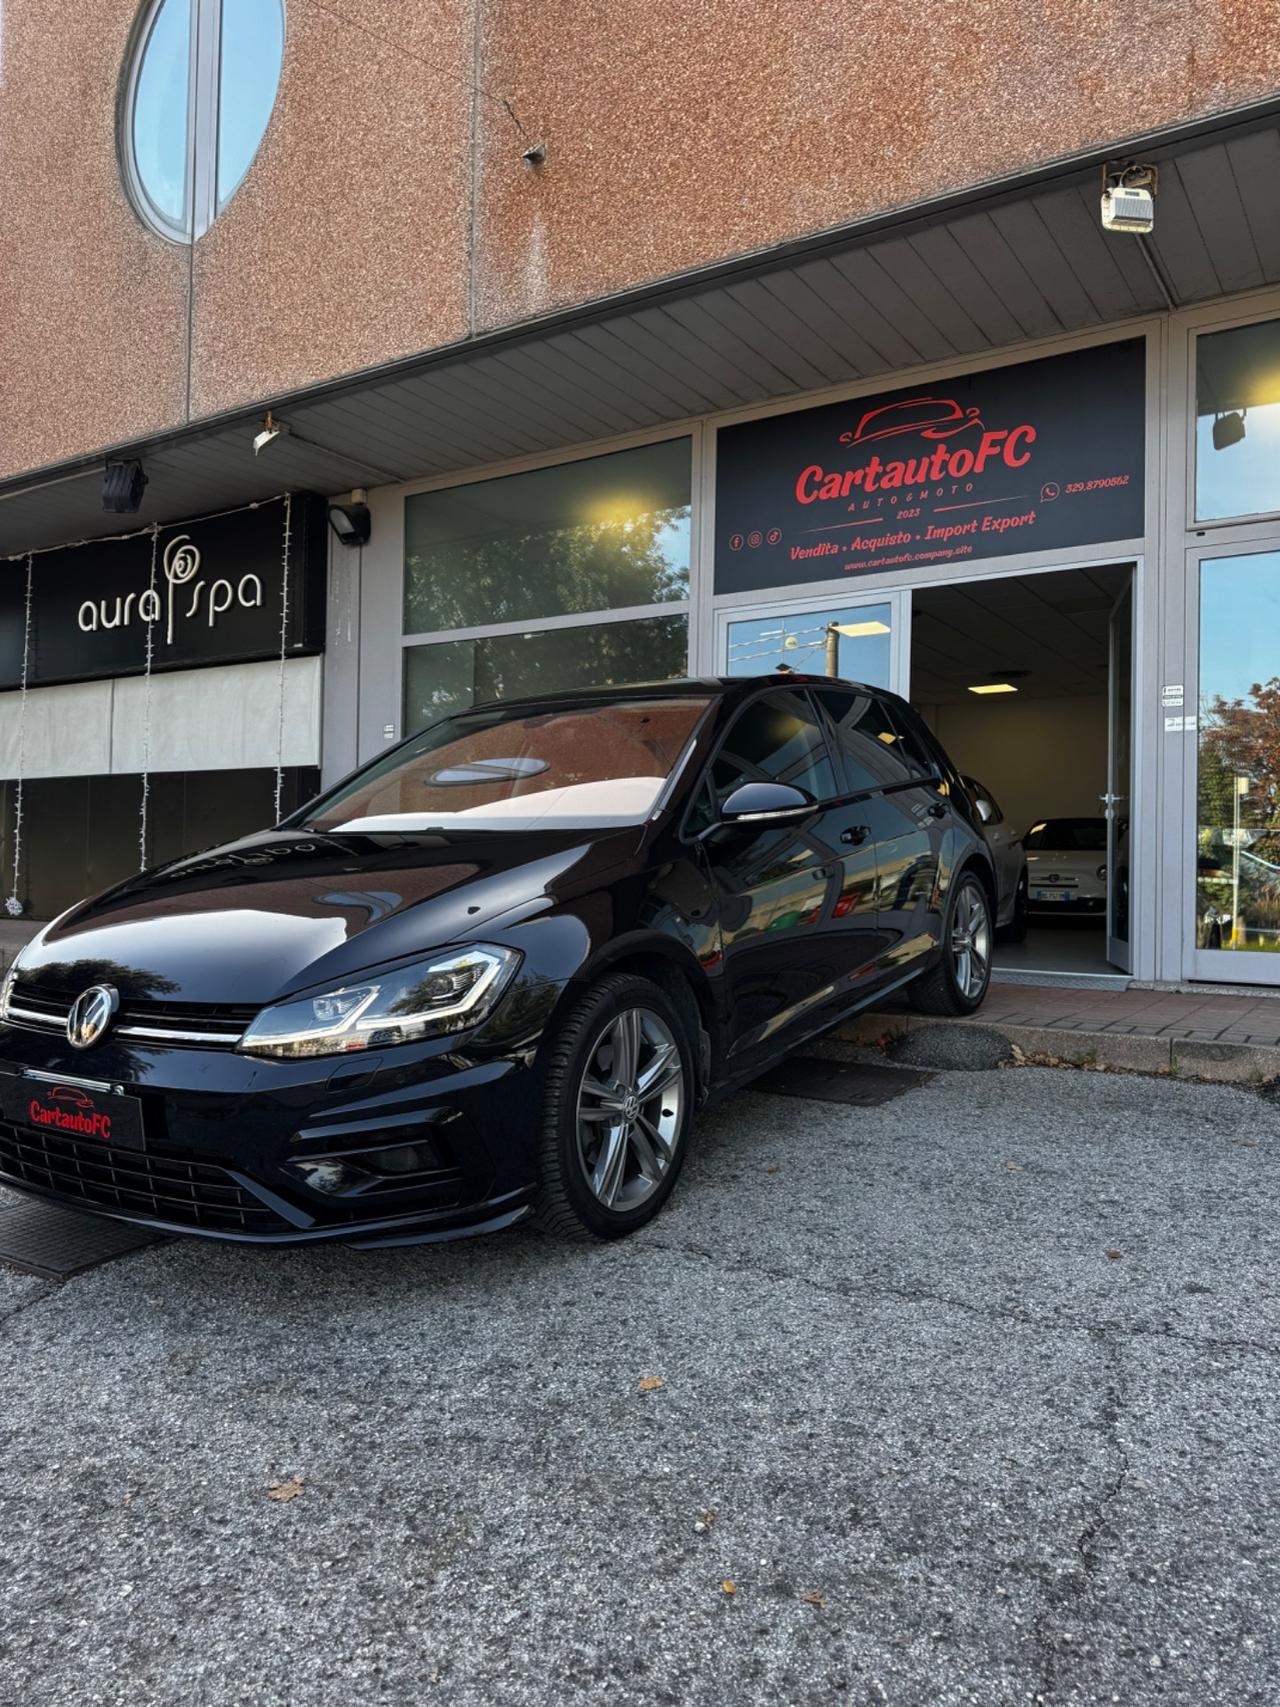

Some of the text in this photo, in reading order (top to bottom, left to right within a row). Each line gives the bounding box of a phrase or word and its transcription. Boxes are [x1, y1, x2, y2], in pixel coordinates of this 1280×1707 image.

[796, 425, 1037, 504] CartautoFC
[790, 511, 1036, 561] Vendita Acquisto Import Export
[896, 508, 921, 520] 2023
[78, 573, 262, 632] aura spa
[30, 1100, 112, 1140] CartautoFC
